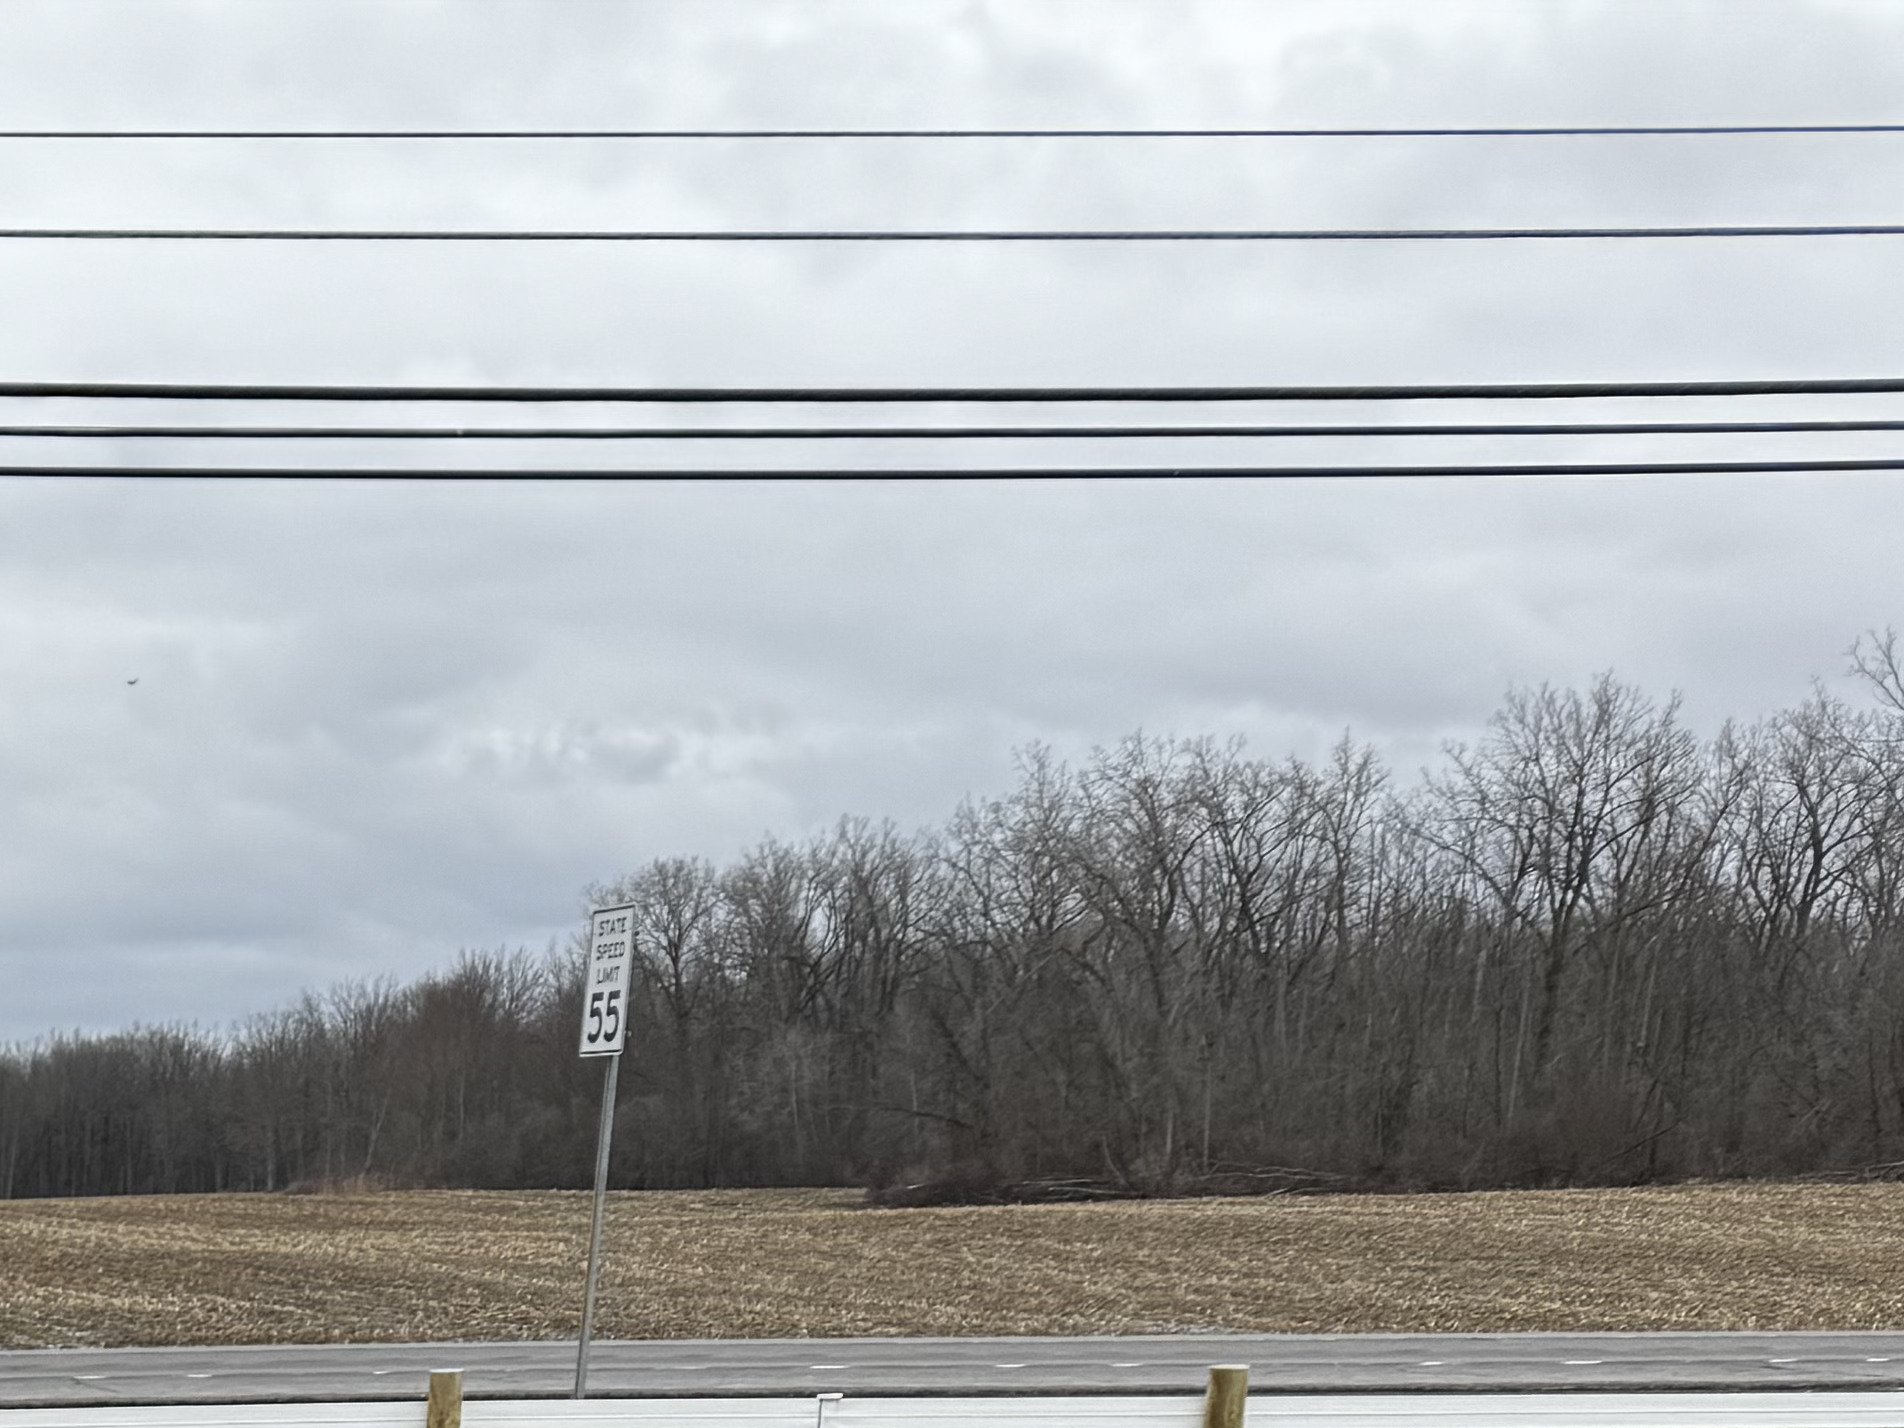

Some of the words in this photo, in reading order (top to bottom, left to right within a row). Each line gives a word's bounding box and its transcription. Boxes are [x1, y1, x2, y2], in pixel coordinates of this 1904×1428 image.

[599, 917, 627, 937] STATE
[596, 941, 625, 961] SPEED
[596, 966, 621, 984] LIMIT
[587, 990, 621, 1043] 55
